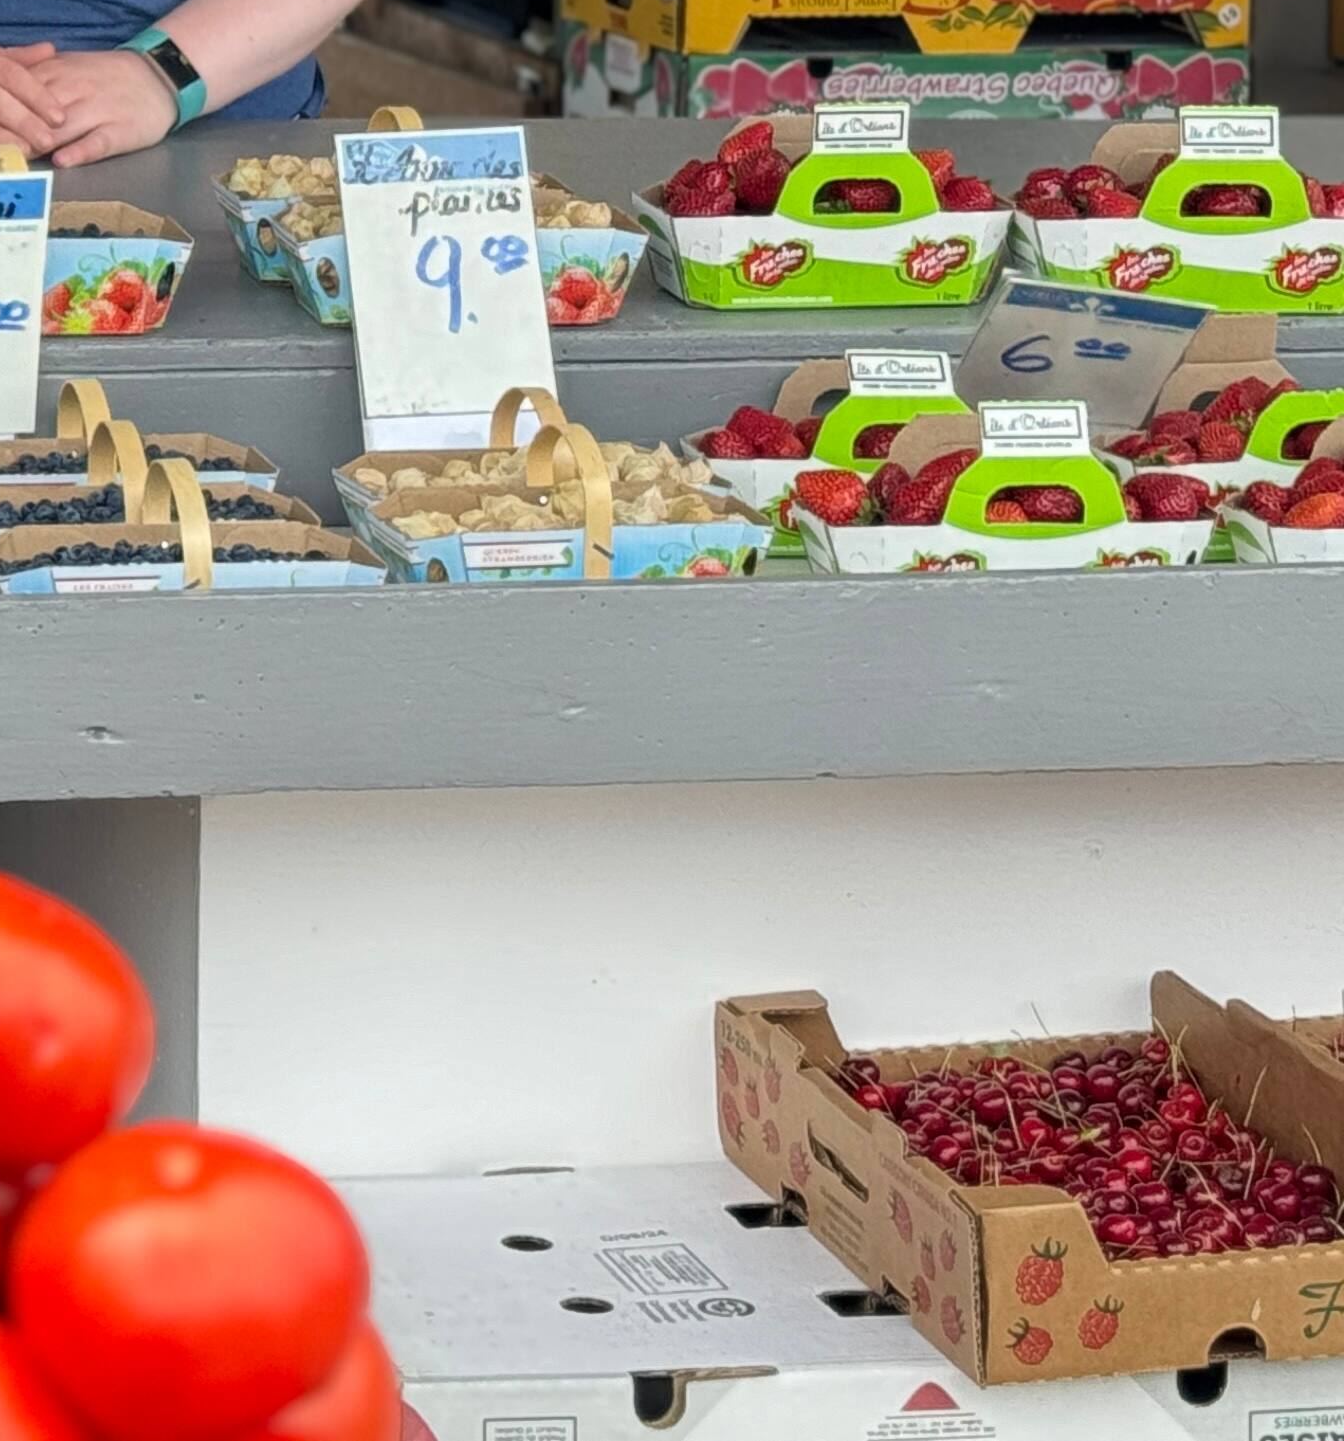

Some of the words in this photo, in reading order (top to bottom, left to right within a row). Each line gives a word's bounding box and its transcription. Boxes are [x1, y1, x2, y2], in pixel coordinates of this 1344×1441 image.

[823, 71, 1009, 104] Strawberries
[1014, 70, 1122, 101] Quebec
[1275, 1415, 1344, 1429] WBERRIES
